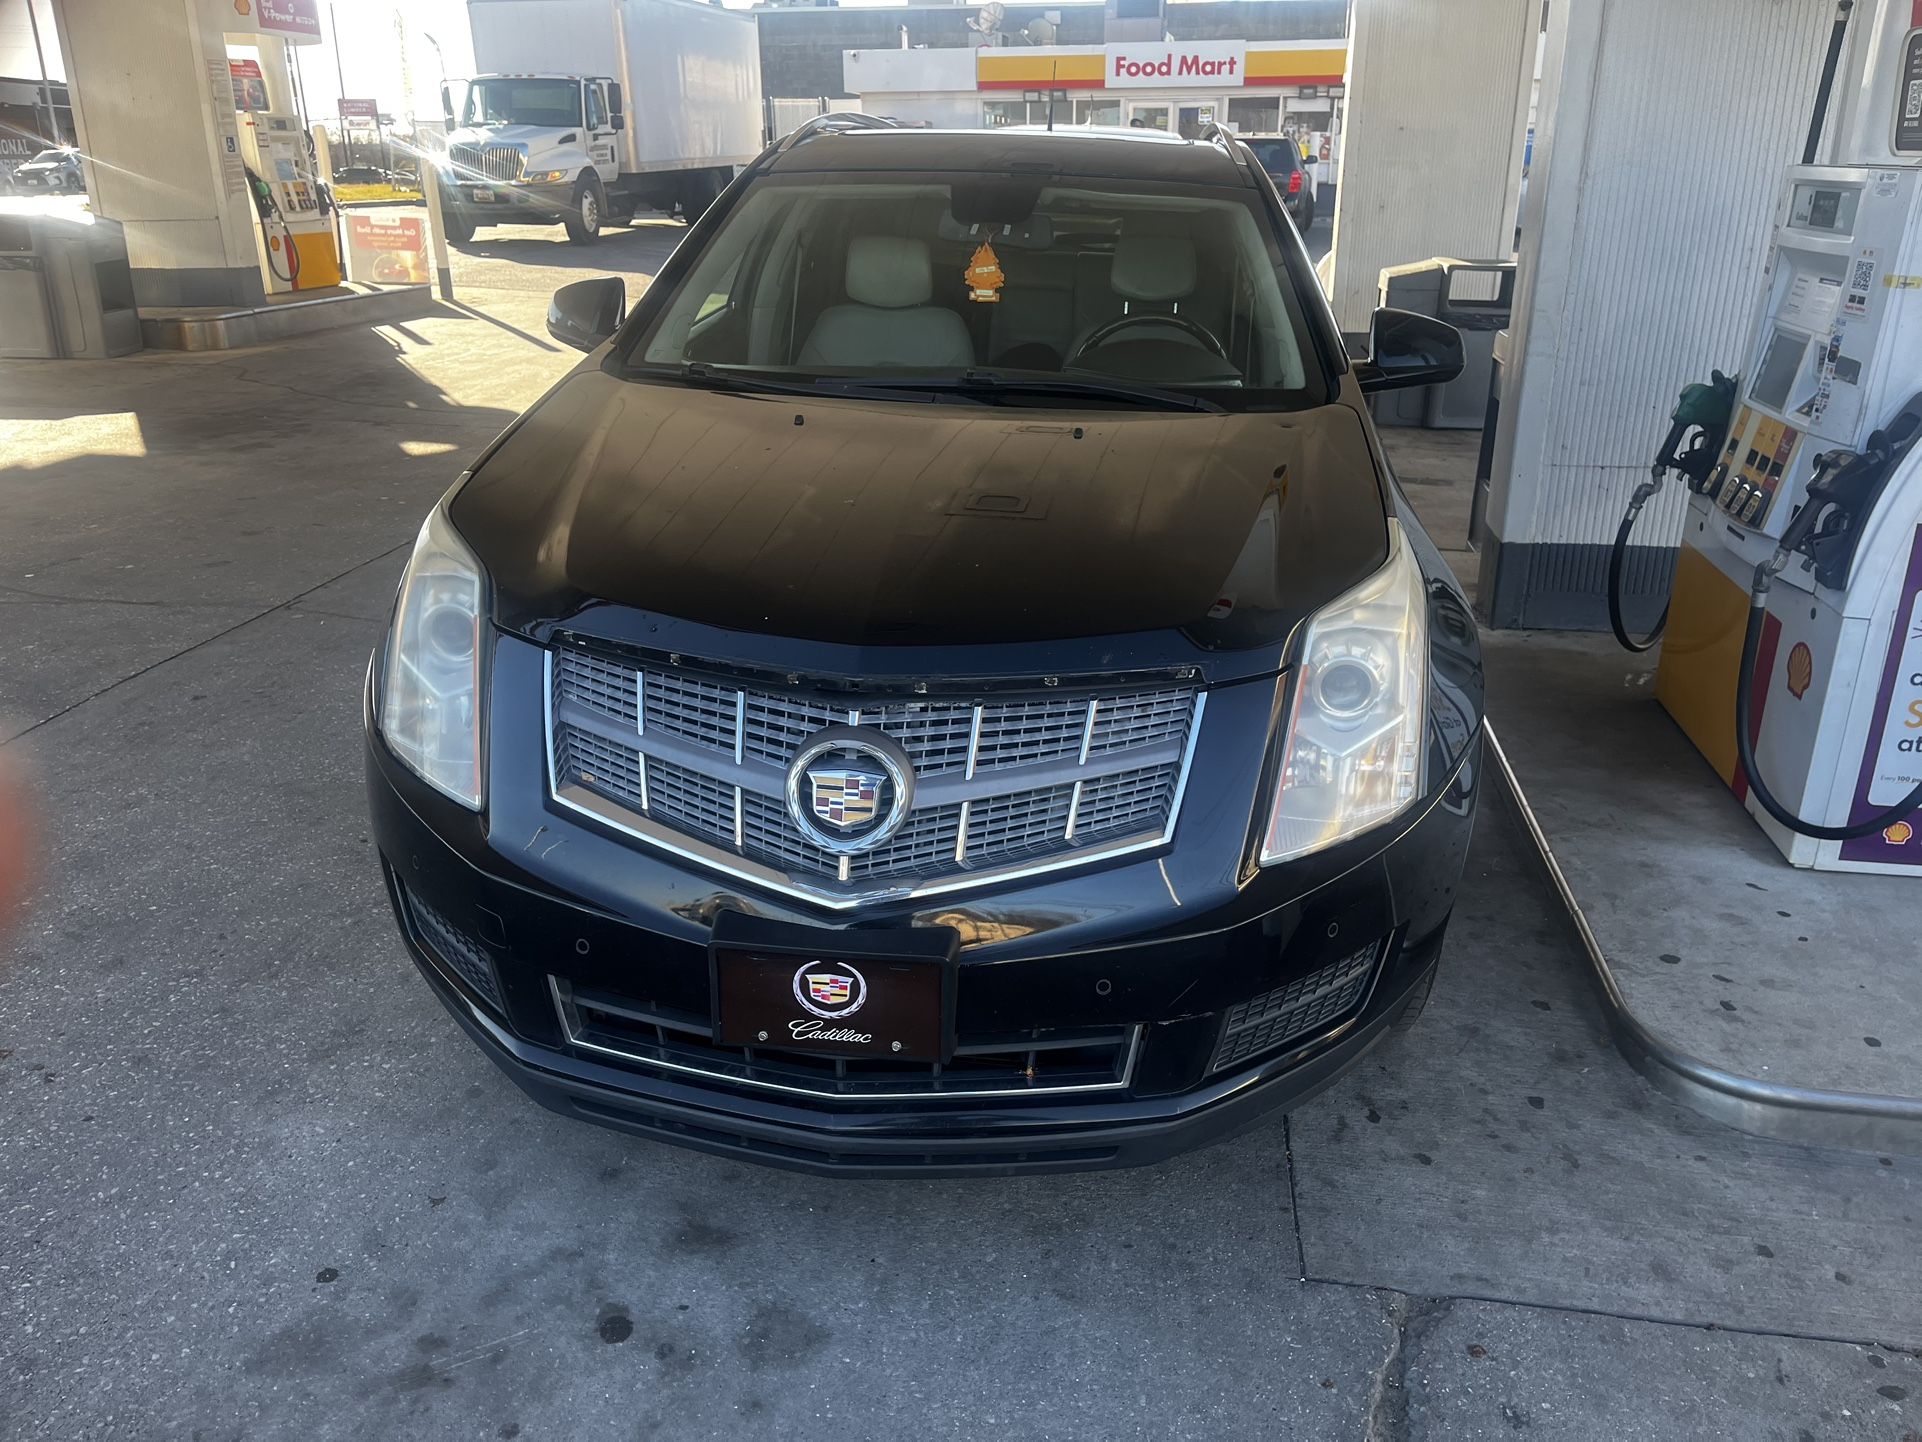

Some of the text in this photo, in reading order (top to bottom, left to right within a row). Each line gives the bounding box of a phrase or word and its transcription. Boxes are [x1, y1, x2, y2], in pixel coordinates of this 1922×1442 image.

[262, 8, 294, 22] V-Power
[1115, 53, 1237, 77] Food Mart
[0, 139, 32, 155] ONAL
[1897, 775, 1910, 784] 100
[788, 1019, 872, 1043] Cadillac
